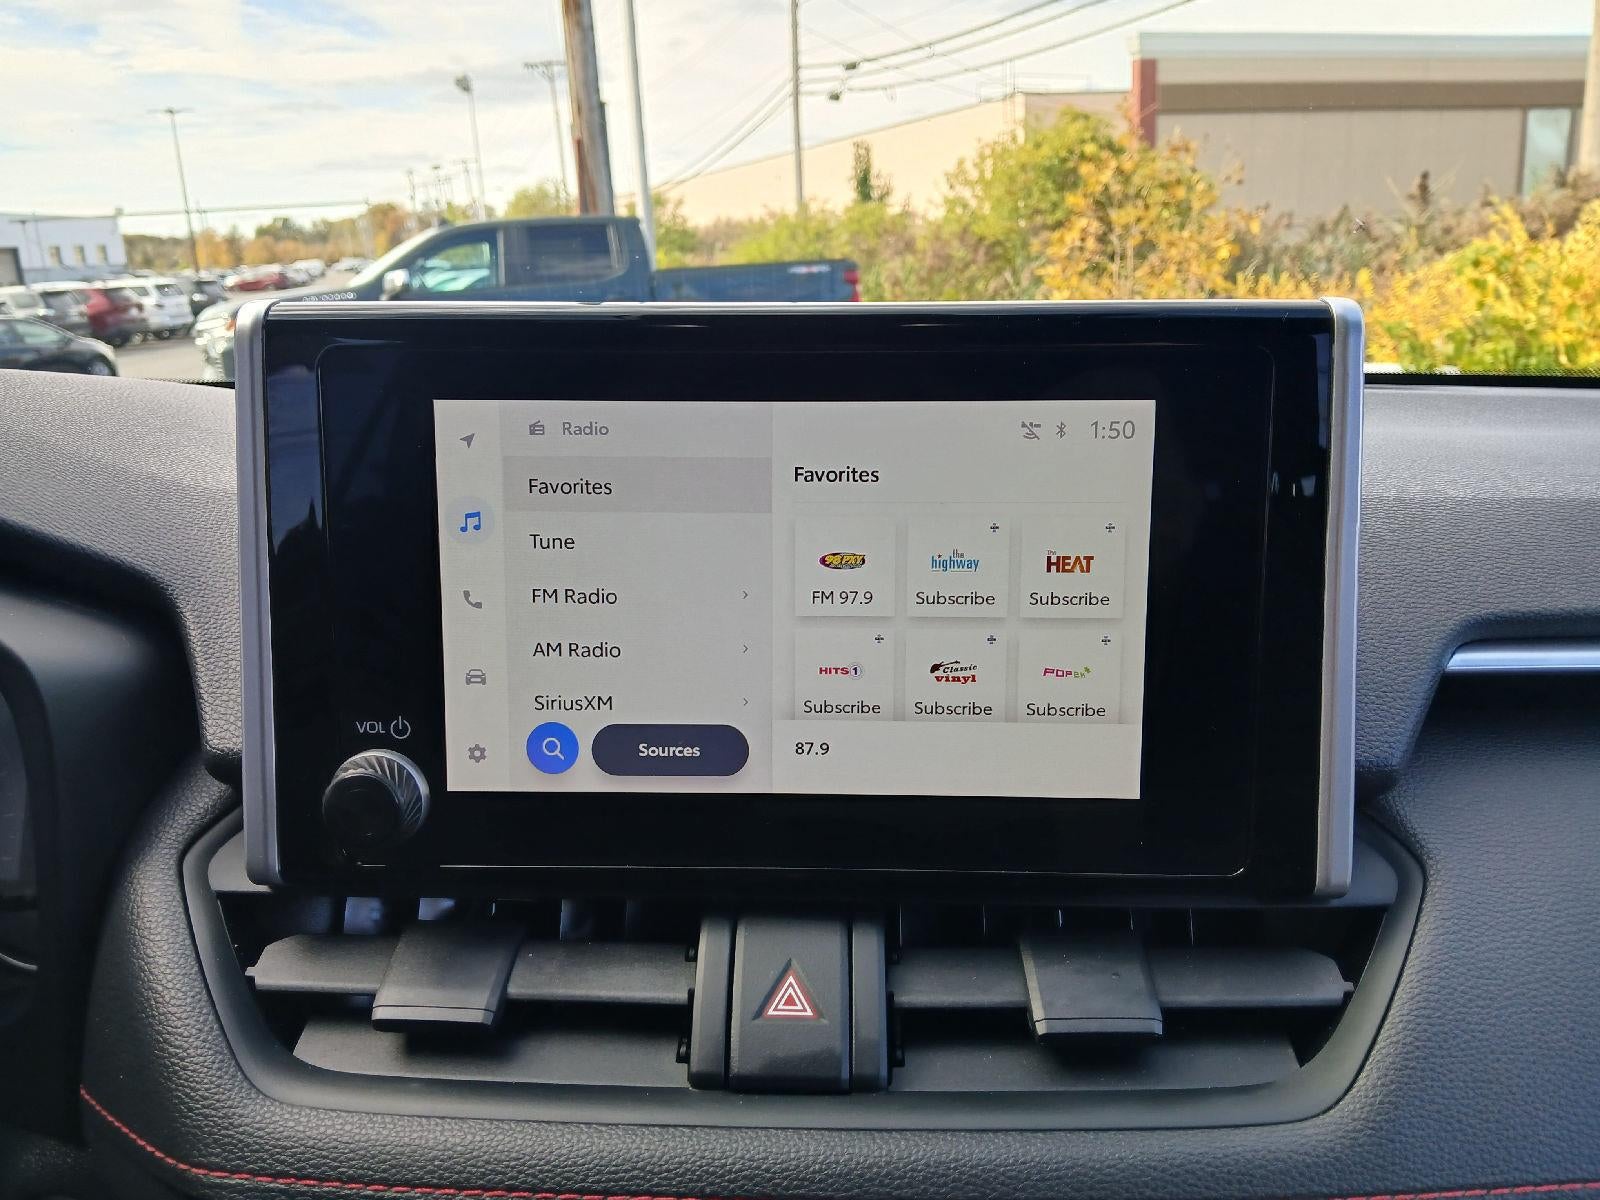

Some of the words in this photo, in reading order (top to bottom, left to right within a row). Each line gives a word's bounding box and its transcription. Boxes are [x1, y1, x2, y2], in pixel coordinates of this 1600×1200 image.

[562, 421, 610, 437] Radio
[1090, 420, 1136, 440] 1:50
[794, 465, 880, 483] Favorites
[528, 477, 613, 495] Favorites
[529, 533, 576, 551] Tune
[931, 554, 980, 573] highway
[1046, 555, 1095, 573] HEAT
[532, 588, 558, 604] FM
[564, 587, 618, 605] Radio
[812, 590, 834, 605] FM
[839, 590, 873, 605] 97.9
[915, 590, 996, 606] Subscribe
[1029, 591, 1110, 607] Subscribe
[533, 642, 562, 657] AM
[568, 641, 621, 658] Radio
[942, 664, 978, 674] Classic
[934, 674, 977, 685] vinyl
[534, 694, 613, 711] SiriusXM
[803, 699, 881, 714] Subscribe
[914, 701, 993, 716] Subscribe
[1026, 702, 1106, 717] Subscribe
[355, 721, 386, 734] VOL
[638, 743, 701, 758] Sources
[795, 741, 830, 756] 87.9
